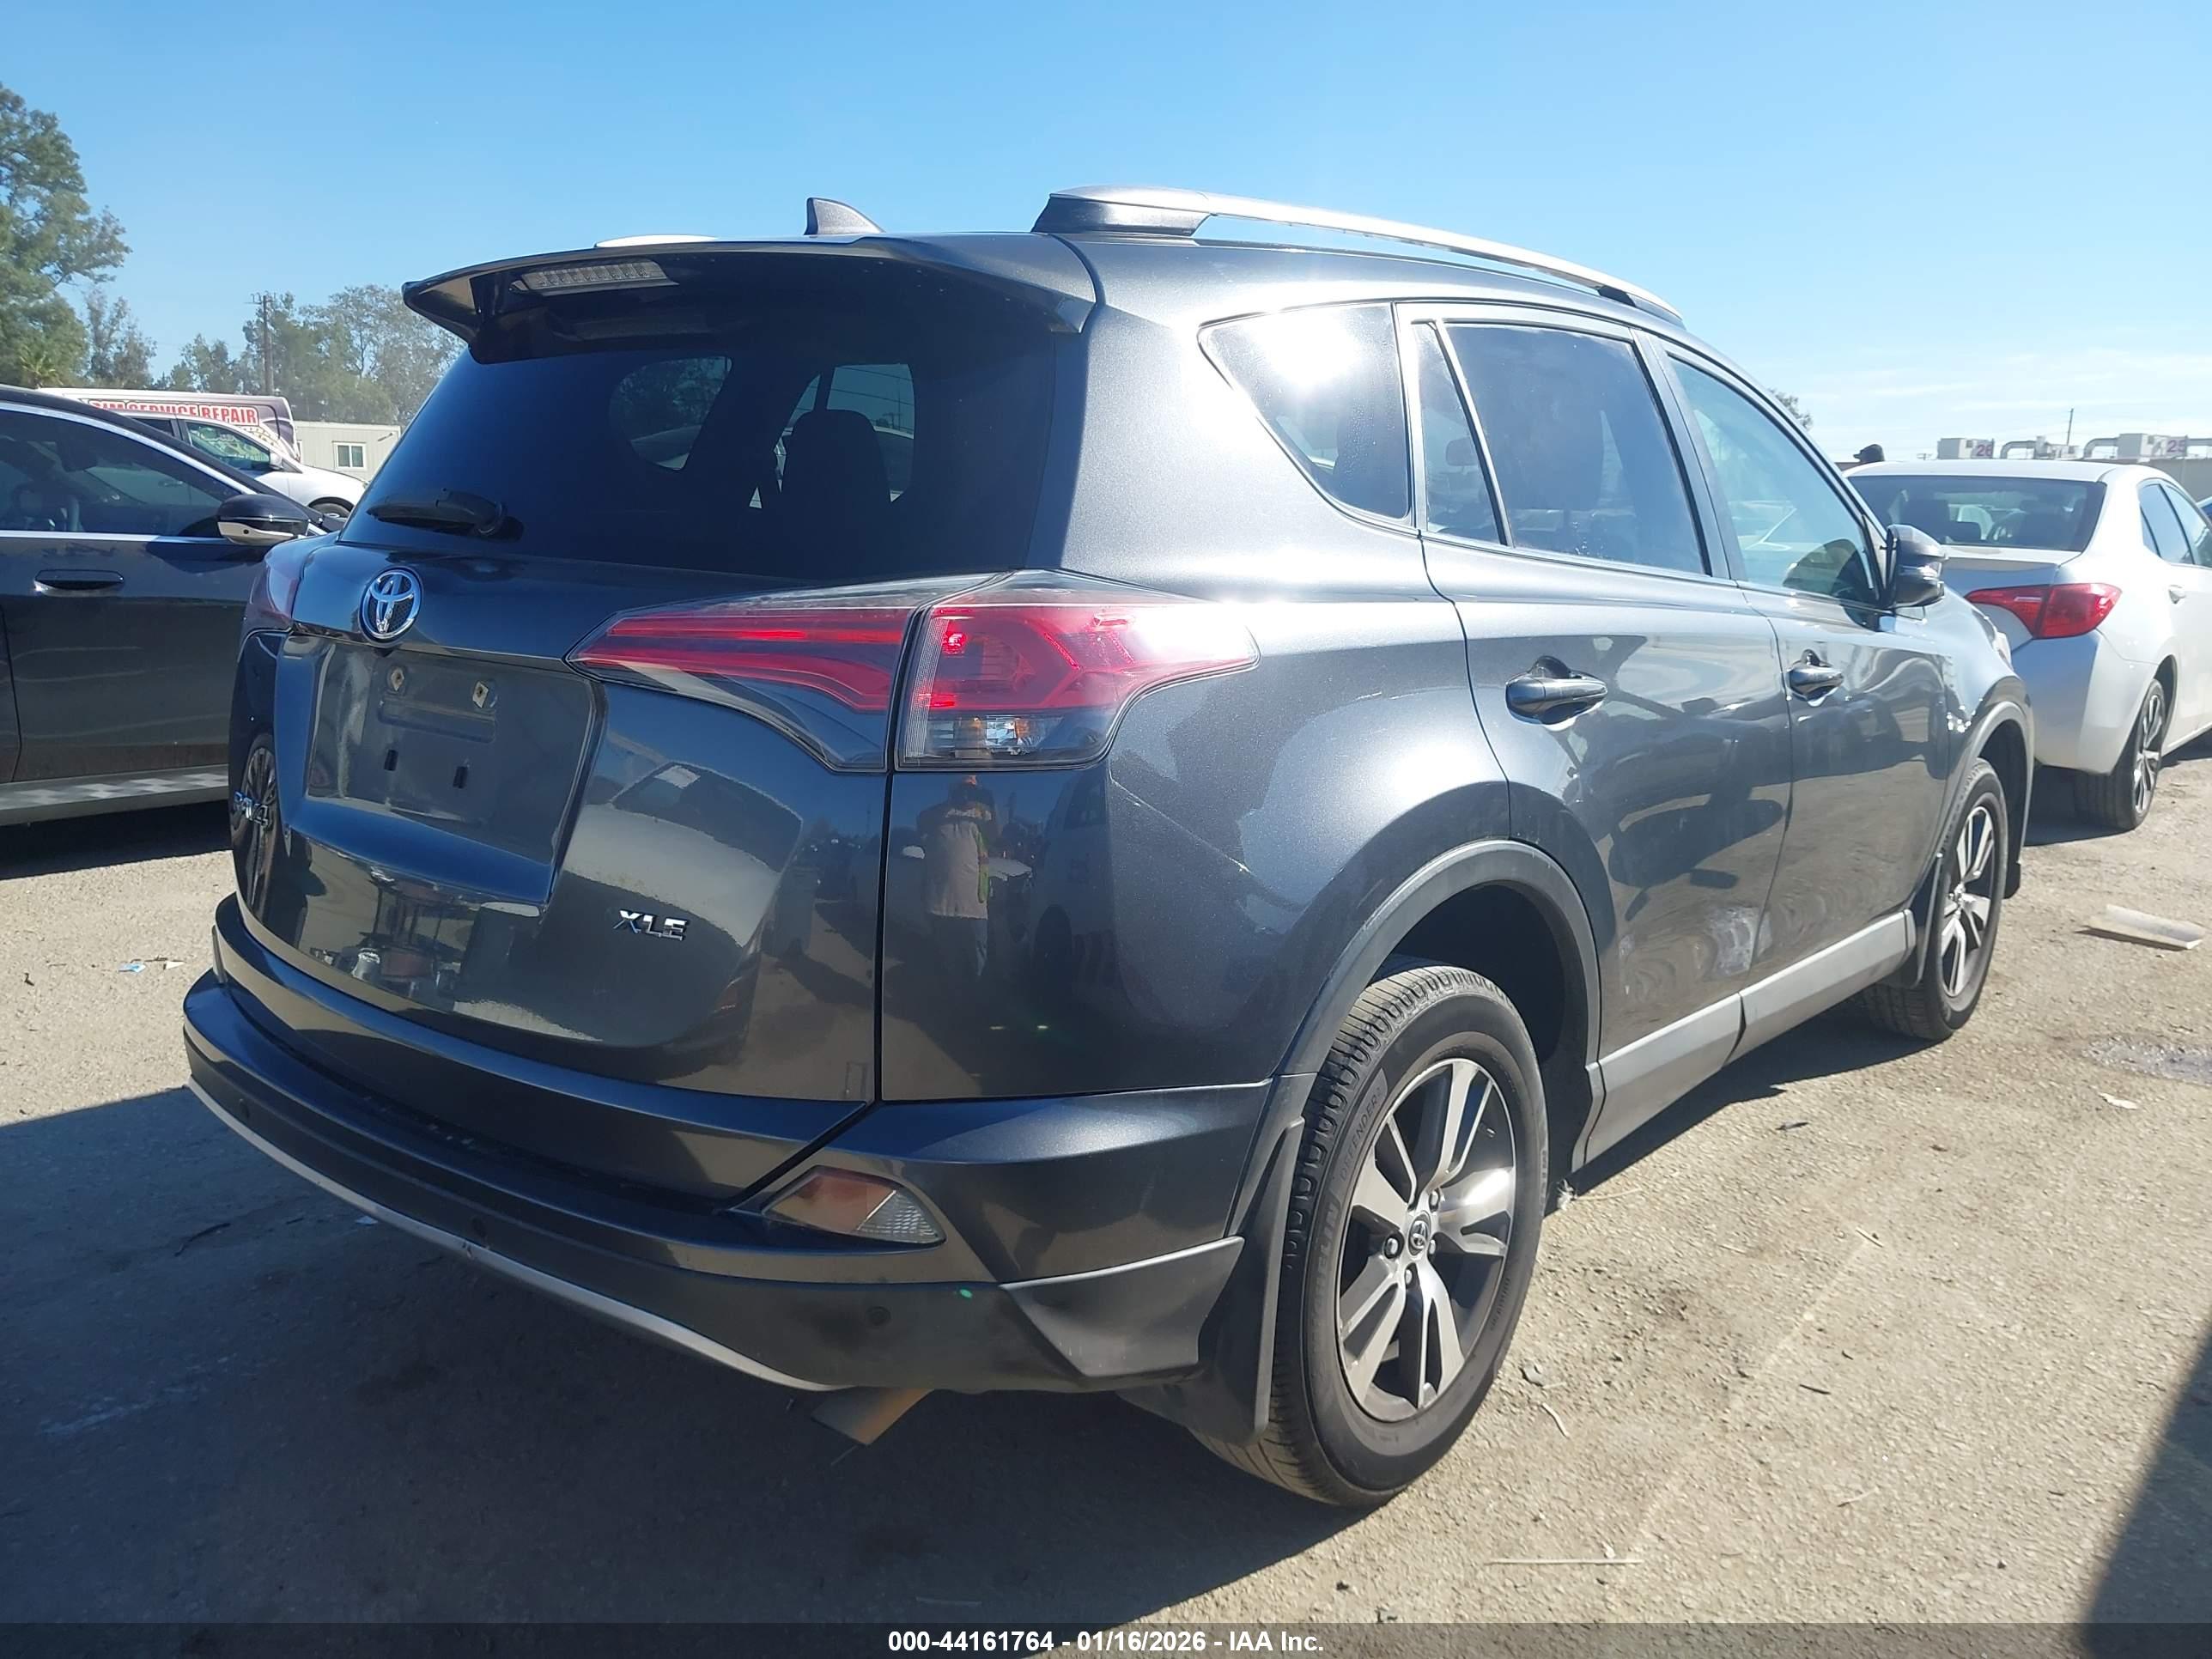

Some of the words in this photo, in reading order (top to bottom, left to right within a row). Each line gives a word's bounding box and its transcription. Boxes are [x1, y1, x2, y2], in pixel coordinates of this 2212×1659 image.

[201, 407, 257, 423] REPAIR
[612, 910, 687, 941] XLE
[1340, 1094, 1378, 1182] DEFENDER
